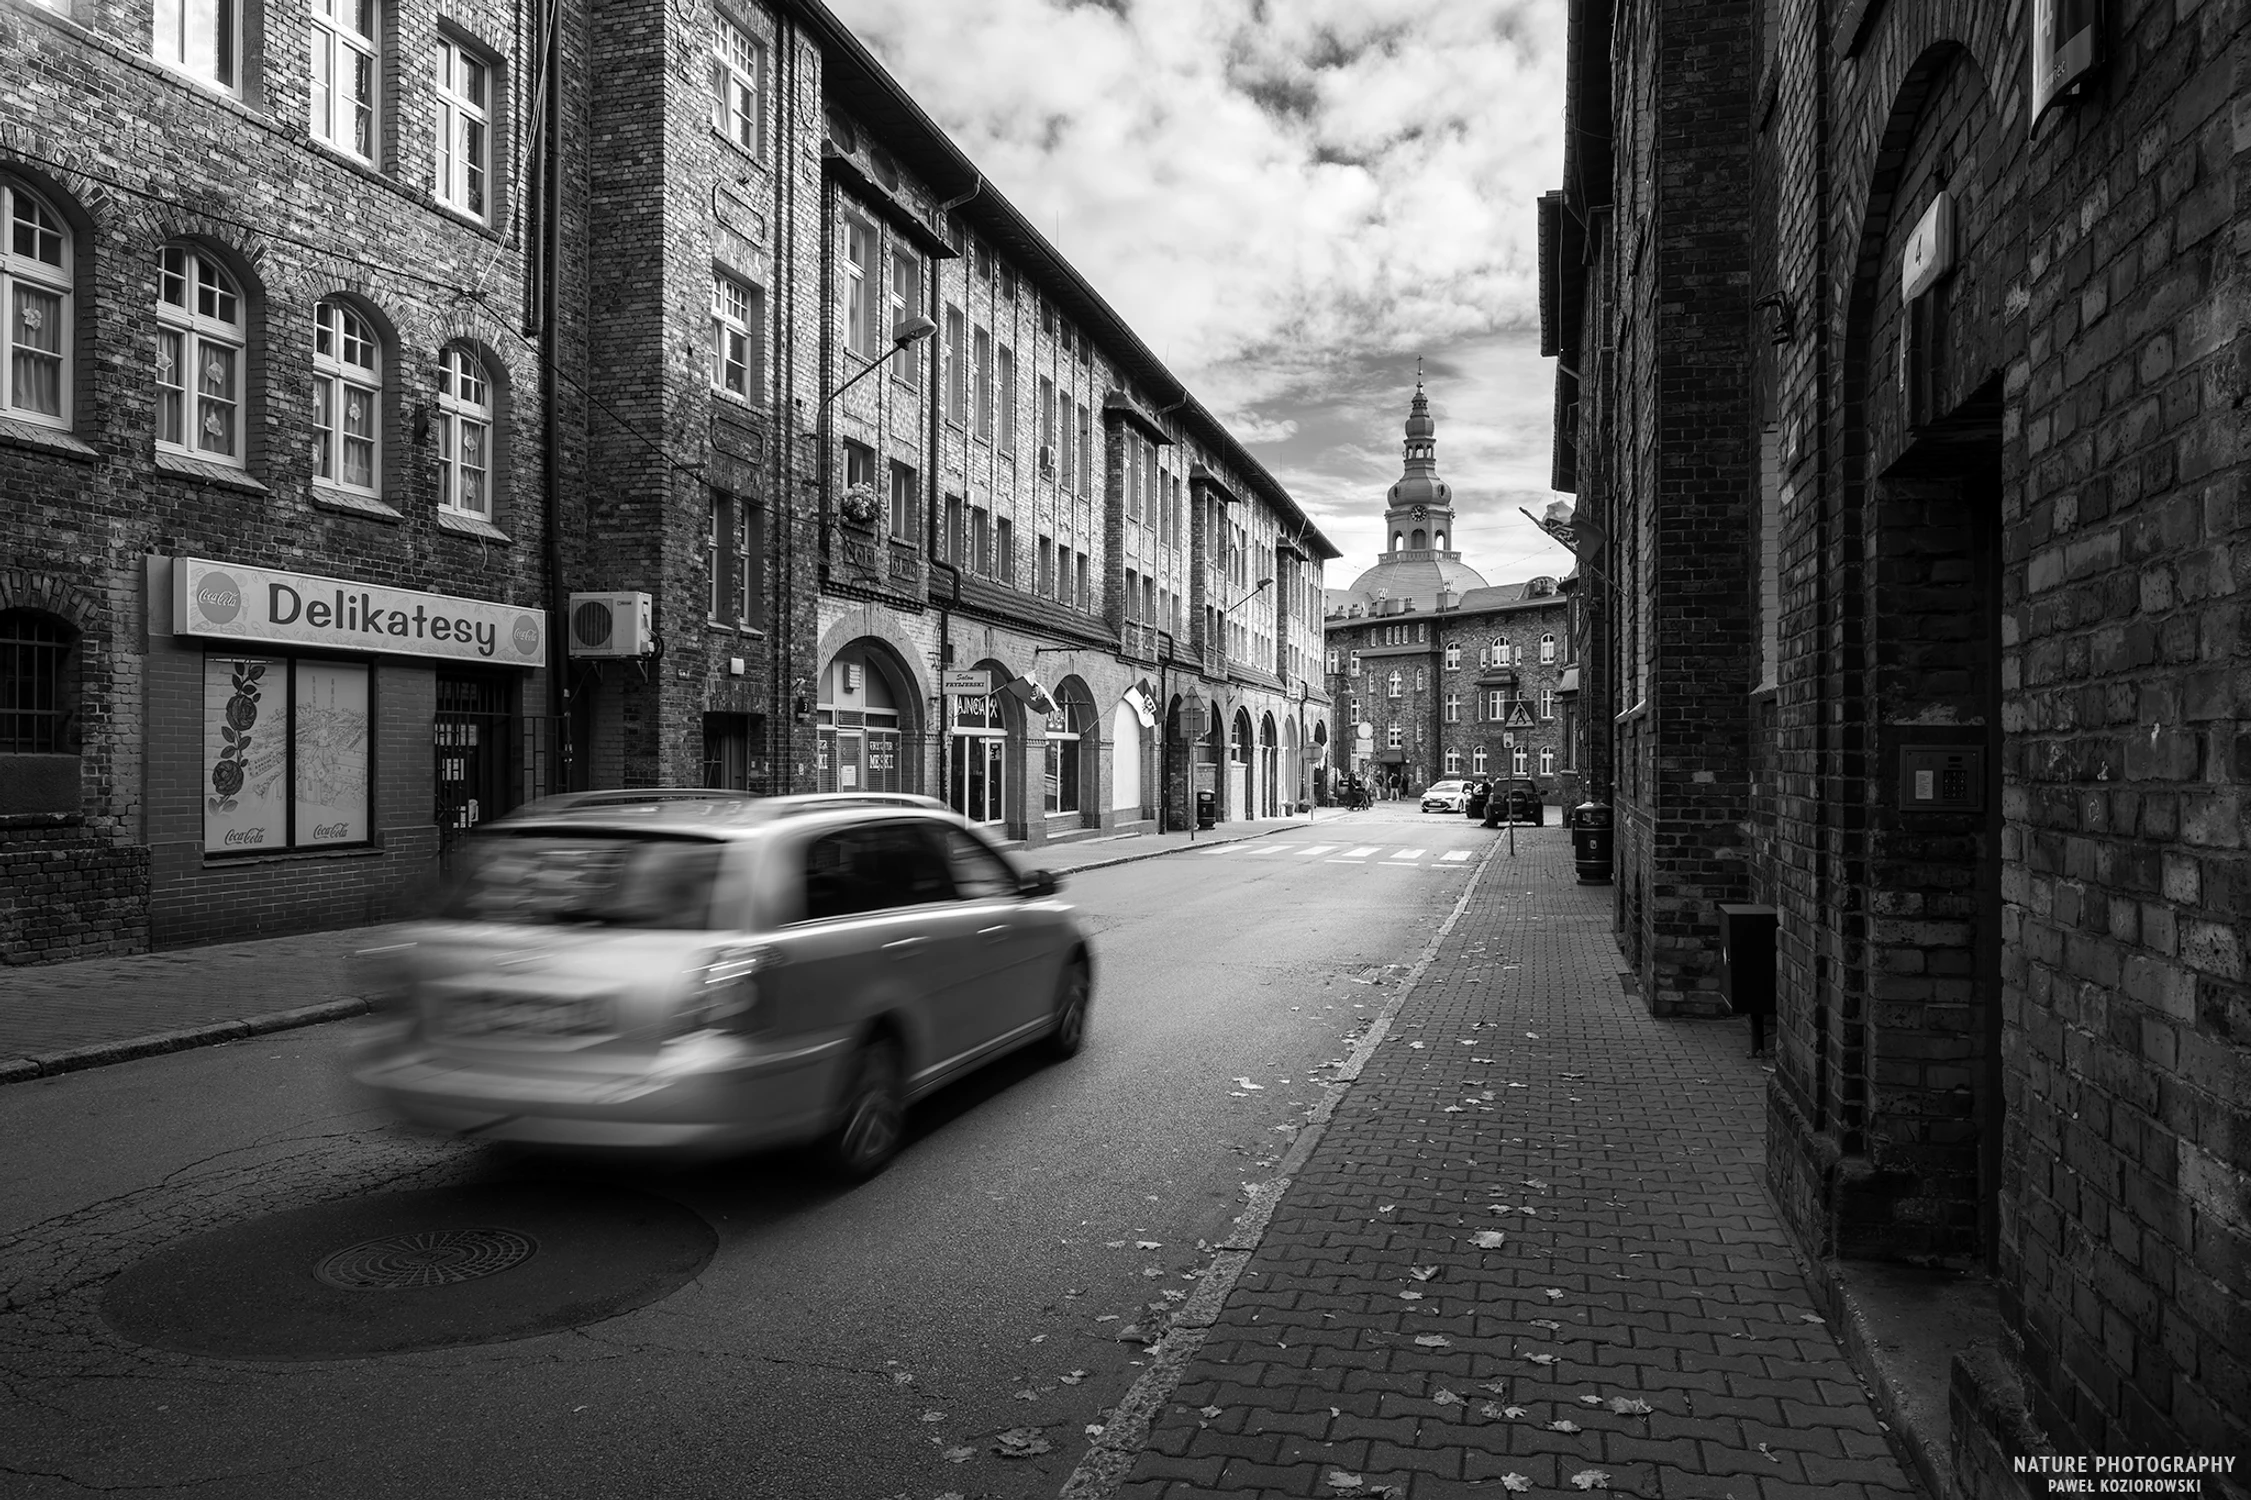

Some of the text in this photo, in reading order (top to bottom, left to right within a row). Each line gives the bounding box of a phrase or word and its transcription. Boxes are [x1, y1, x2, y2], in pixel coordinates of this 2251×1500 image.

[1915, 233, 1923, 267] 4
[268, 582, 496, 657] Delikatesy
[956, 673, 974, 681] Salon
